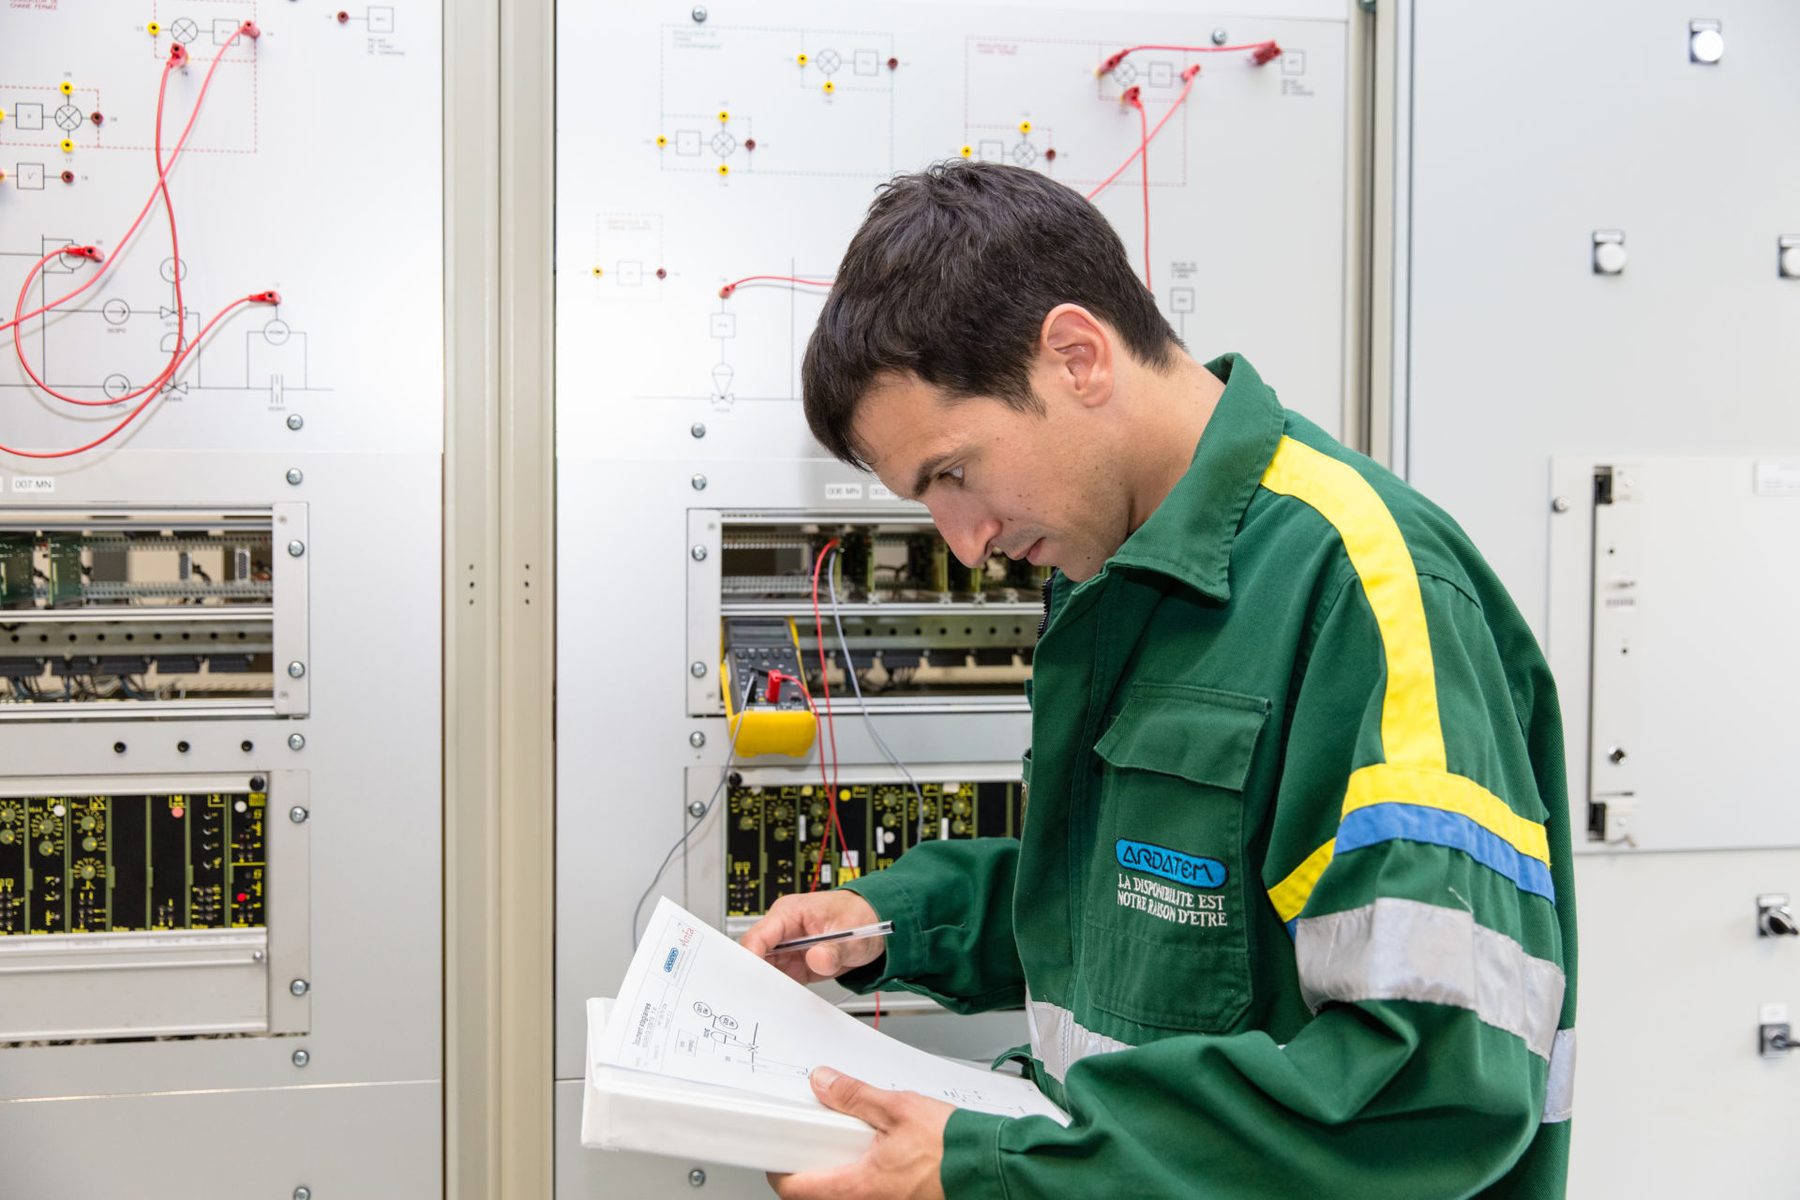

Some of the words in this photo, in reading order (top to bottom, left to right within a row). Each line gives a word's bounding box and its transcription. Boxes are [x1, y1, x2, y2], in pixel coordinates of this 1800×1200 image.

[15, 479, 32, 489] 007
[35, 480, 52, 489] MN
[1123, 845, 1214, 882] ARDATEM
[1117, 873, 1132, 890] LA
[1198, 894, 1226, 911] EST
[1117, 890, 1147, 911] NOTRE
[1148, 898, 1177, 922] RAISON
[1178, 910, 1228, 928] D'ETRE
